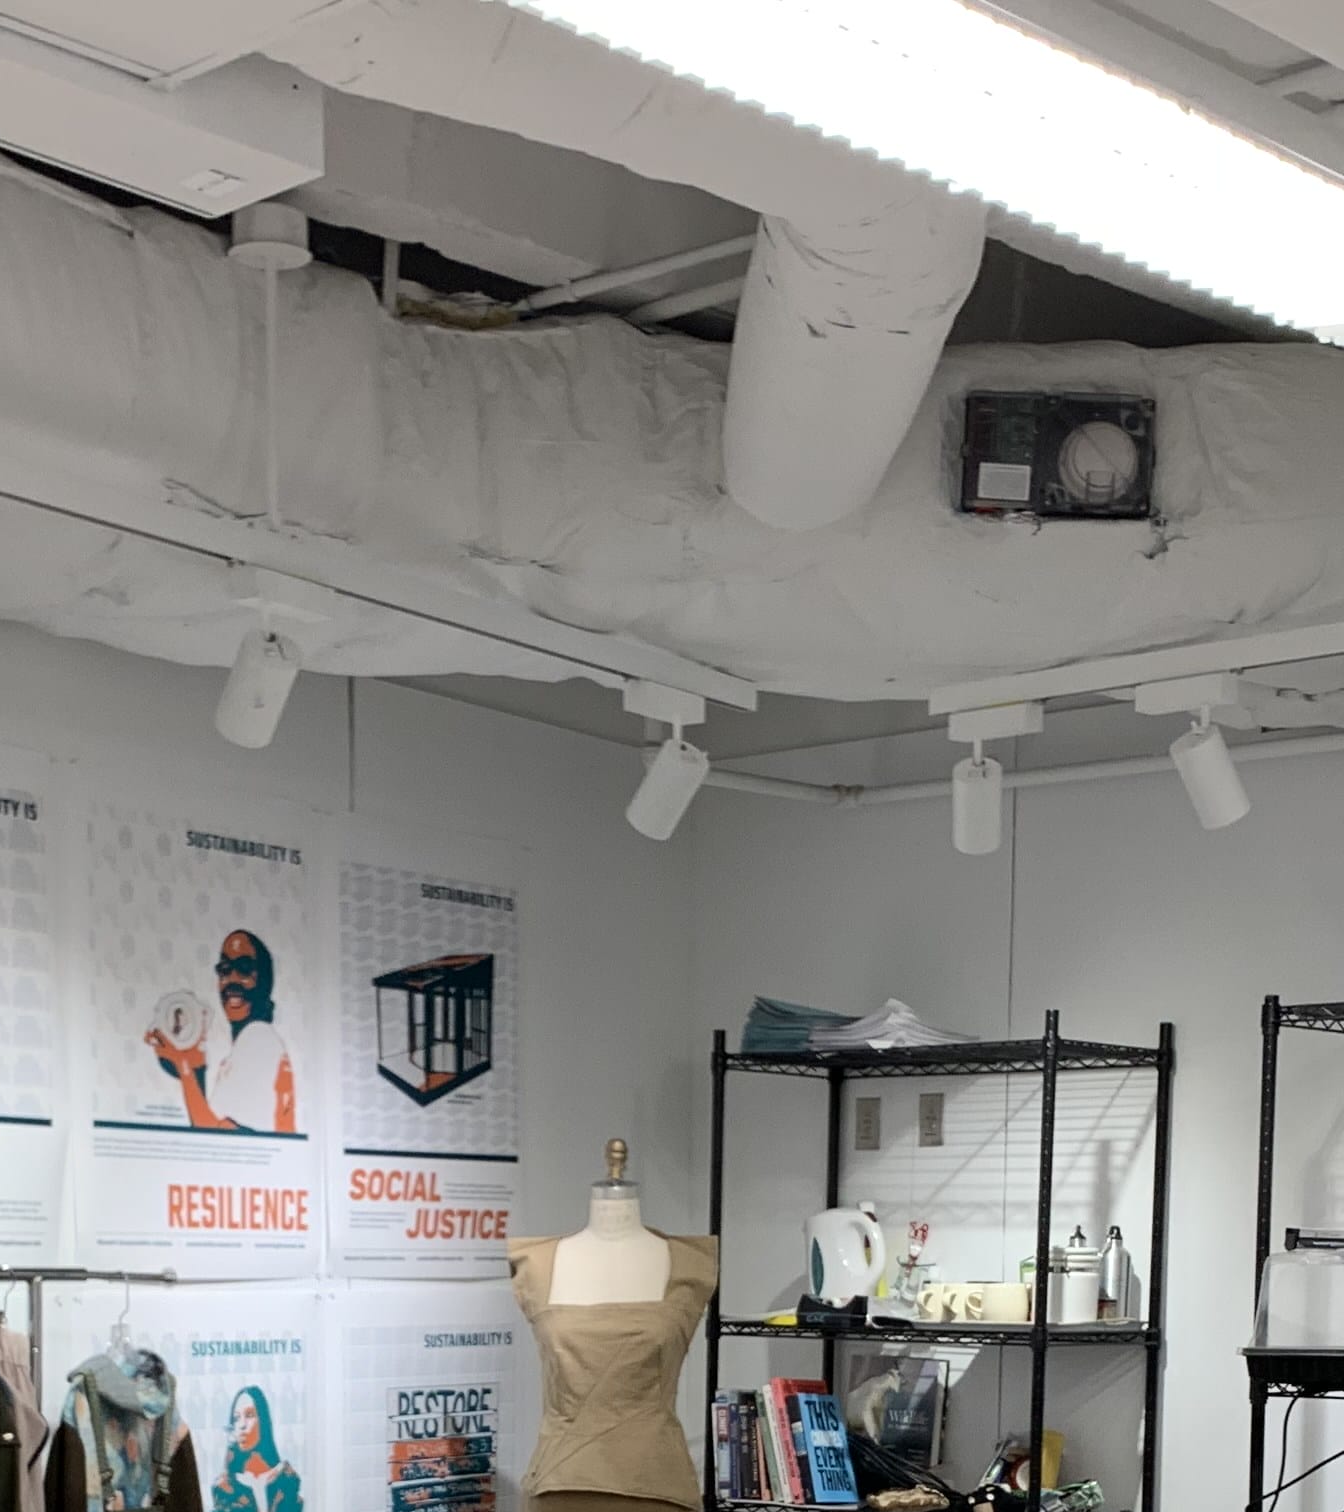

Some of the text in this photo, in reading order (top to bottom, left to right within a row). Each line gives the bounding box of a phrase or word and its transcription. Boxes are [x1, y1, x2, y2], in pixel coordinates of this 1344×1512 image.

[24, 801, 39, 821] IS
[186, 830, 302, 866] SUSTAINABILITY IS
[420, 883, 515, 912] SUSTAINABILITY IS
[348, 1168, 442, 1203] SOCIAL
[167, 1184, 309, 1232] RESILIENCE
[406, 1208, 509, 1241] JUSTICE
[191, 1338, 302, 1357] SUSTAINABILITY IS
[424, 1330, 513, 1348] SUSTAINABILITY IS
[398, 1387, 493, 1439] RESTORE
[804, 1400, 840, 1432] THIS
[814, 1447, 846, 1469] EVERY
[817, 1468, 852, 1492] THING
